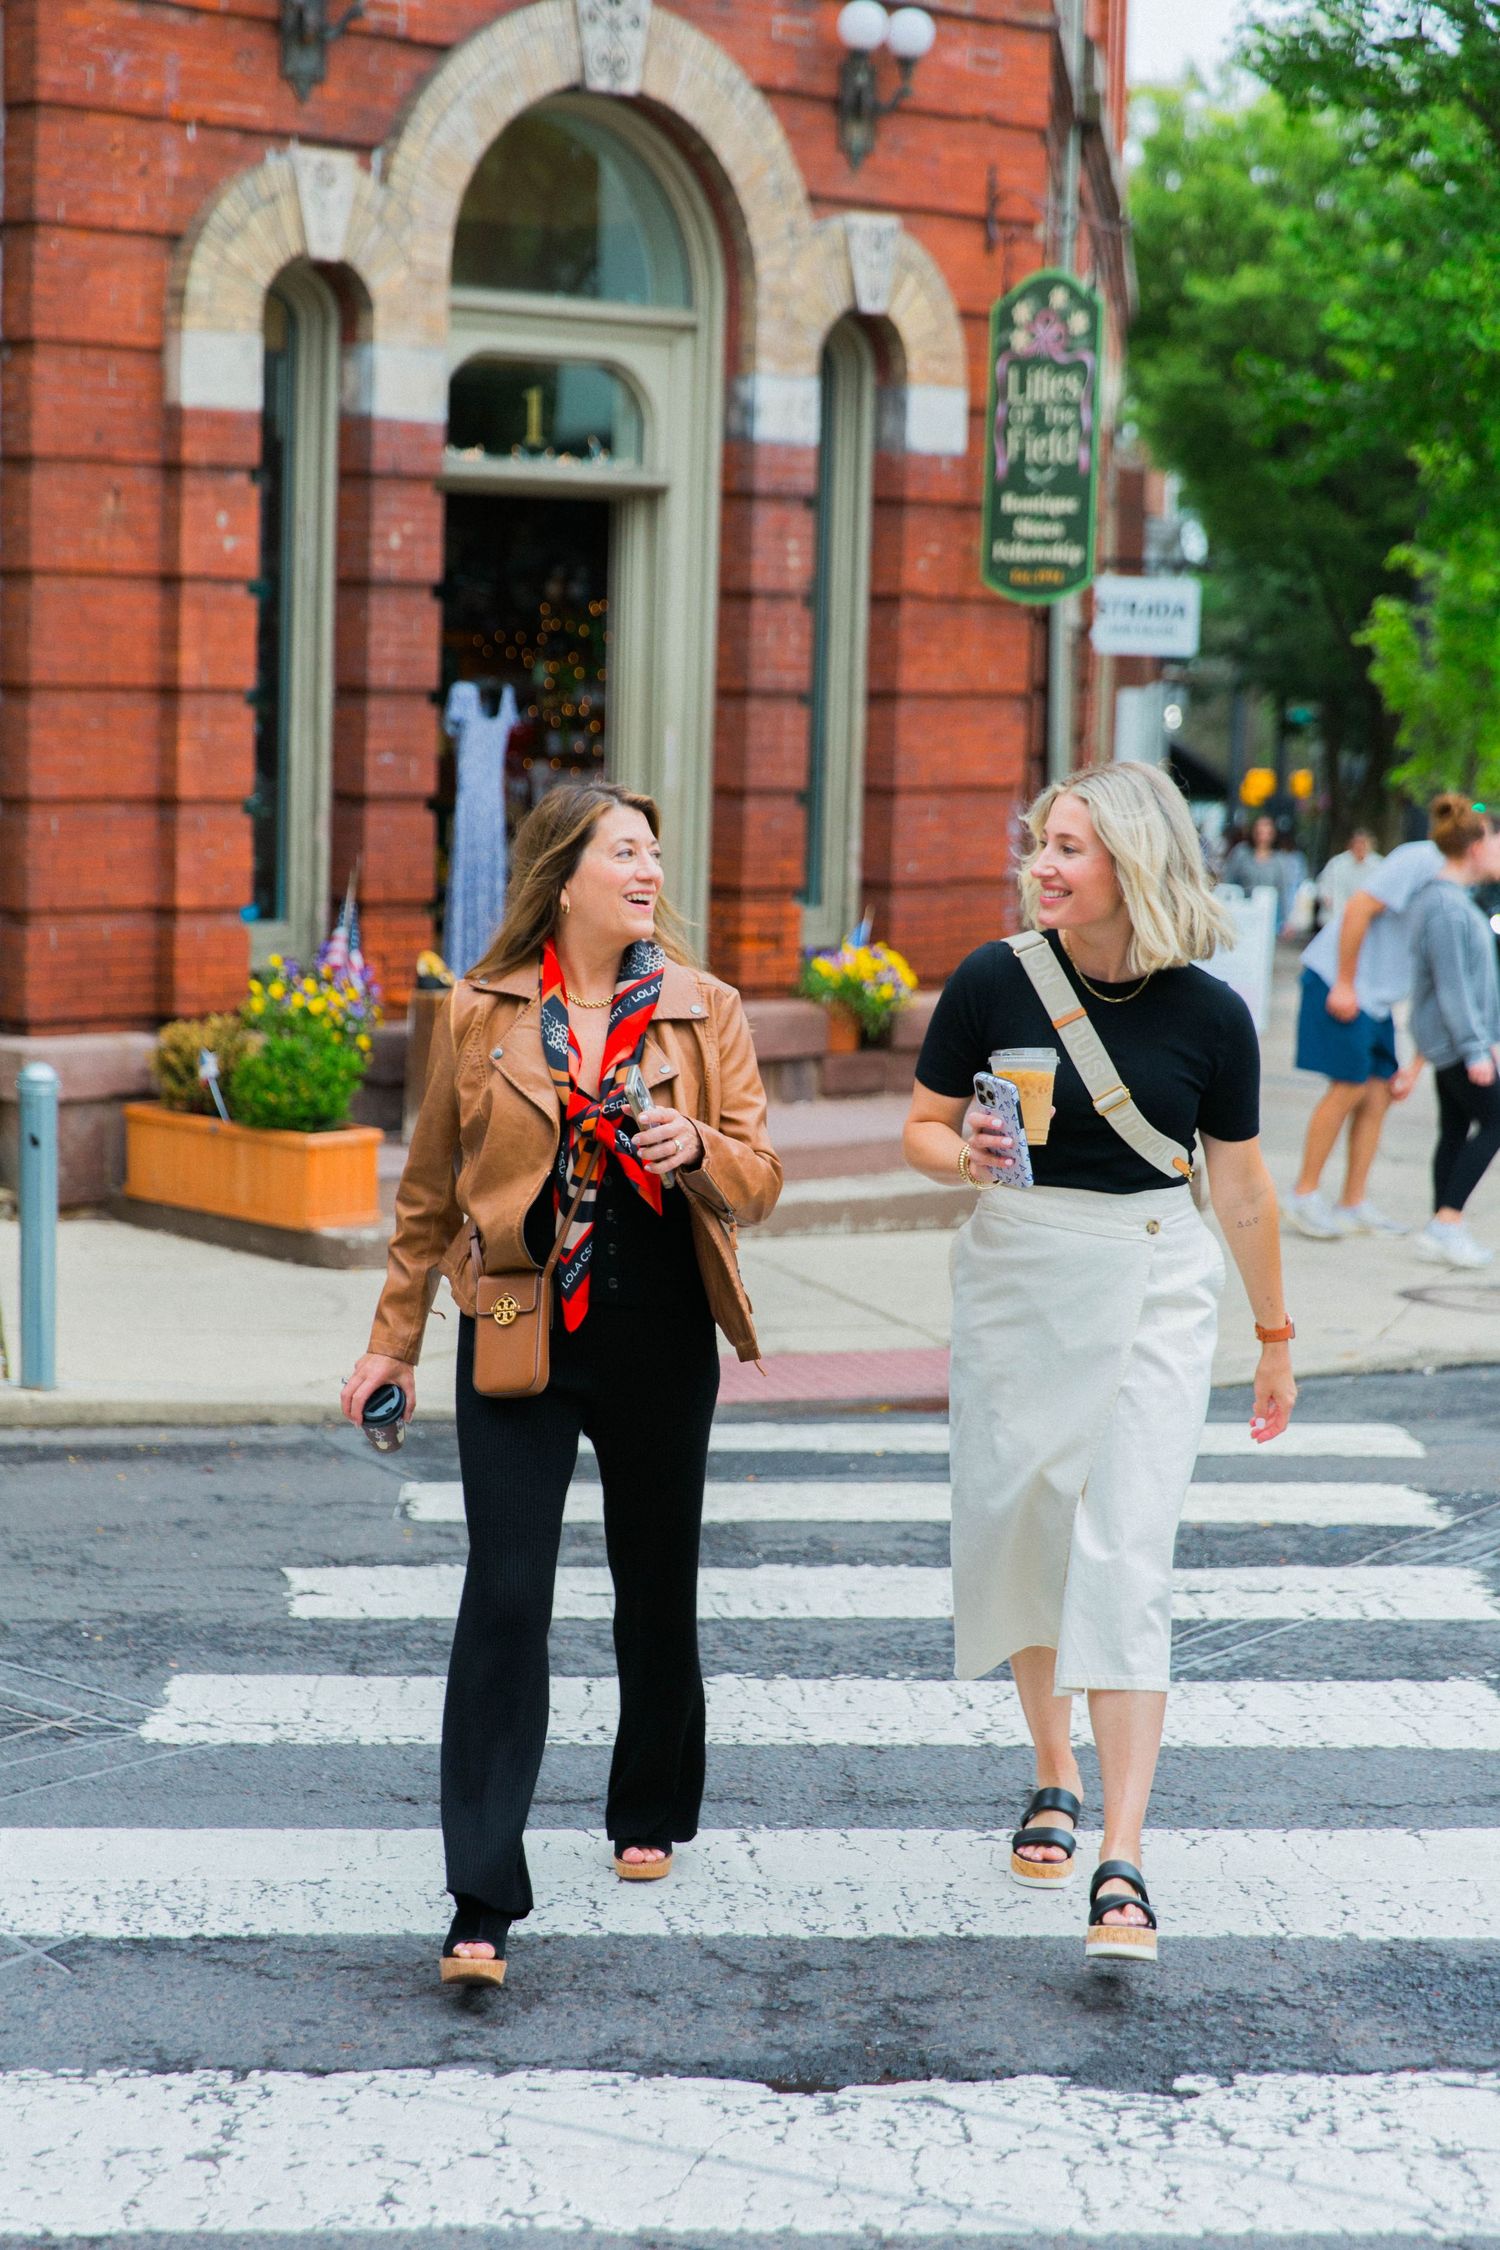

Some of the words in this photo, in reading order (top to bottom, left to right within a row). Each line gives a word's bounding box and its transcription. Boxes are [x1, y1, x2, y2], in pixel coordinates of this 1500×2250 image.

[1006, 425, 1080, 466] Field
[630, 985, 658, 1003] LOLA
[561, 1262, 583, 1289] LOLA
